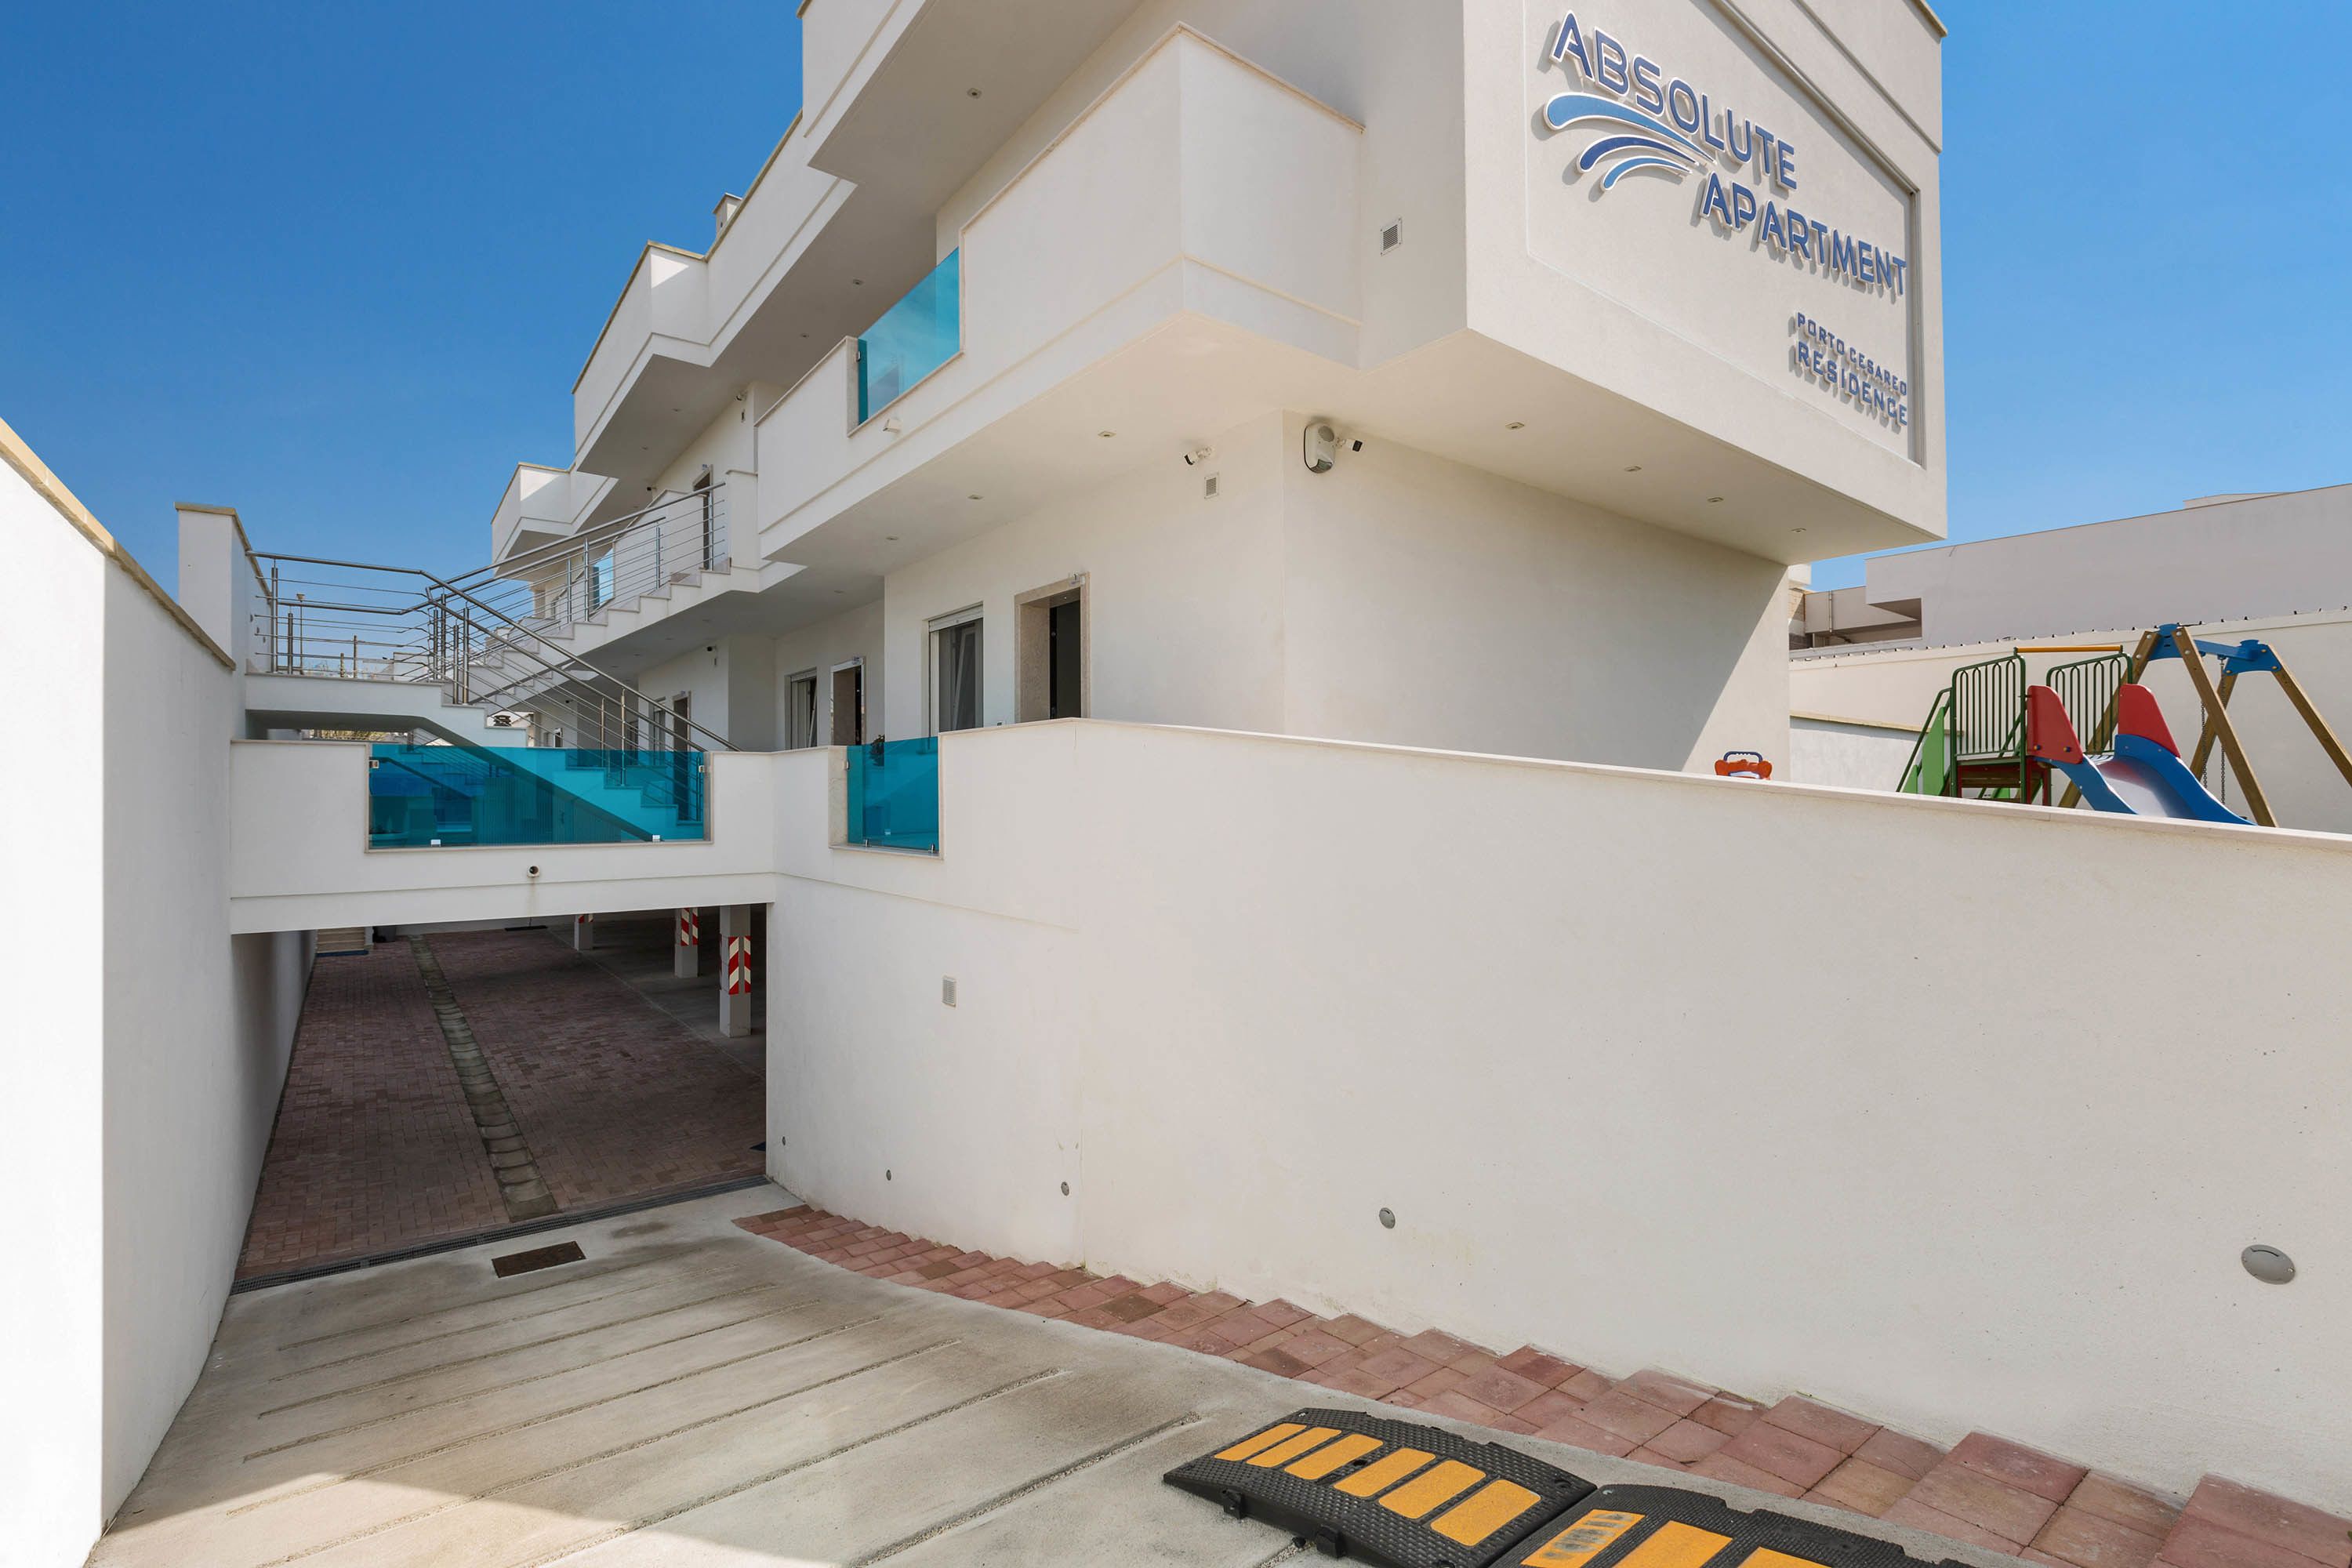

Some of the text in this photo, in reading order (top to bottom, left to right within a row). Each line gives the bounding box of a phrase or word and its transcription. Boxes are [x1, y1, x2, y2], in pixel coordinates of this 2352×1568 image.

[1550, 10, 1797, 190] ABSOLUTE
[1700, 171, 1907, 296] APARTMENT
[1797, 312, 1907, 396] PORTO CESAREO
[1797, 340, 1907, 426] RESIDENCE
